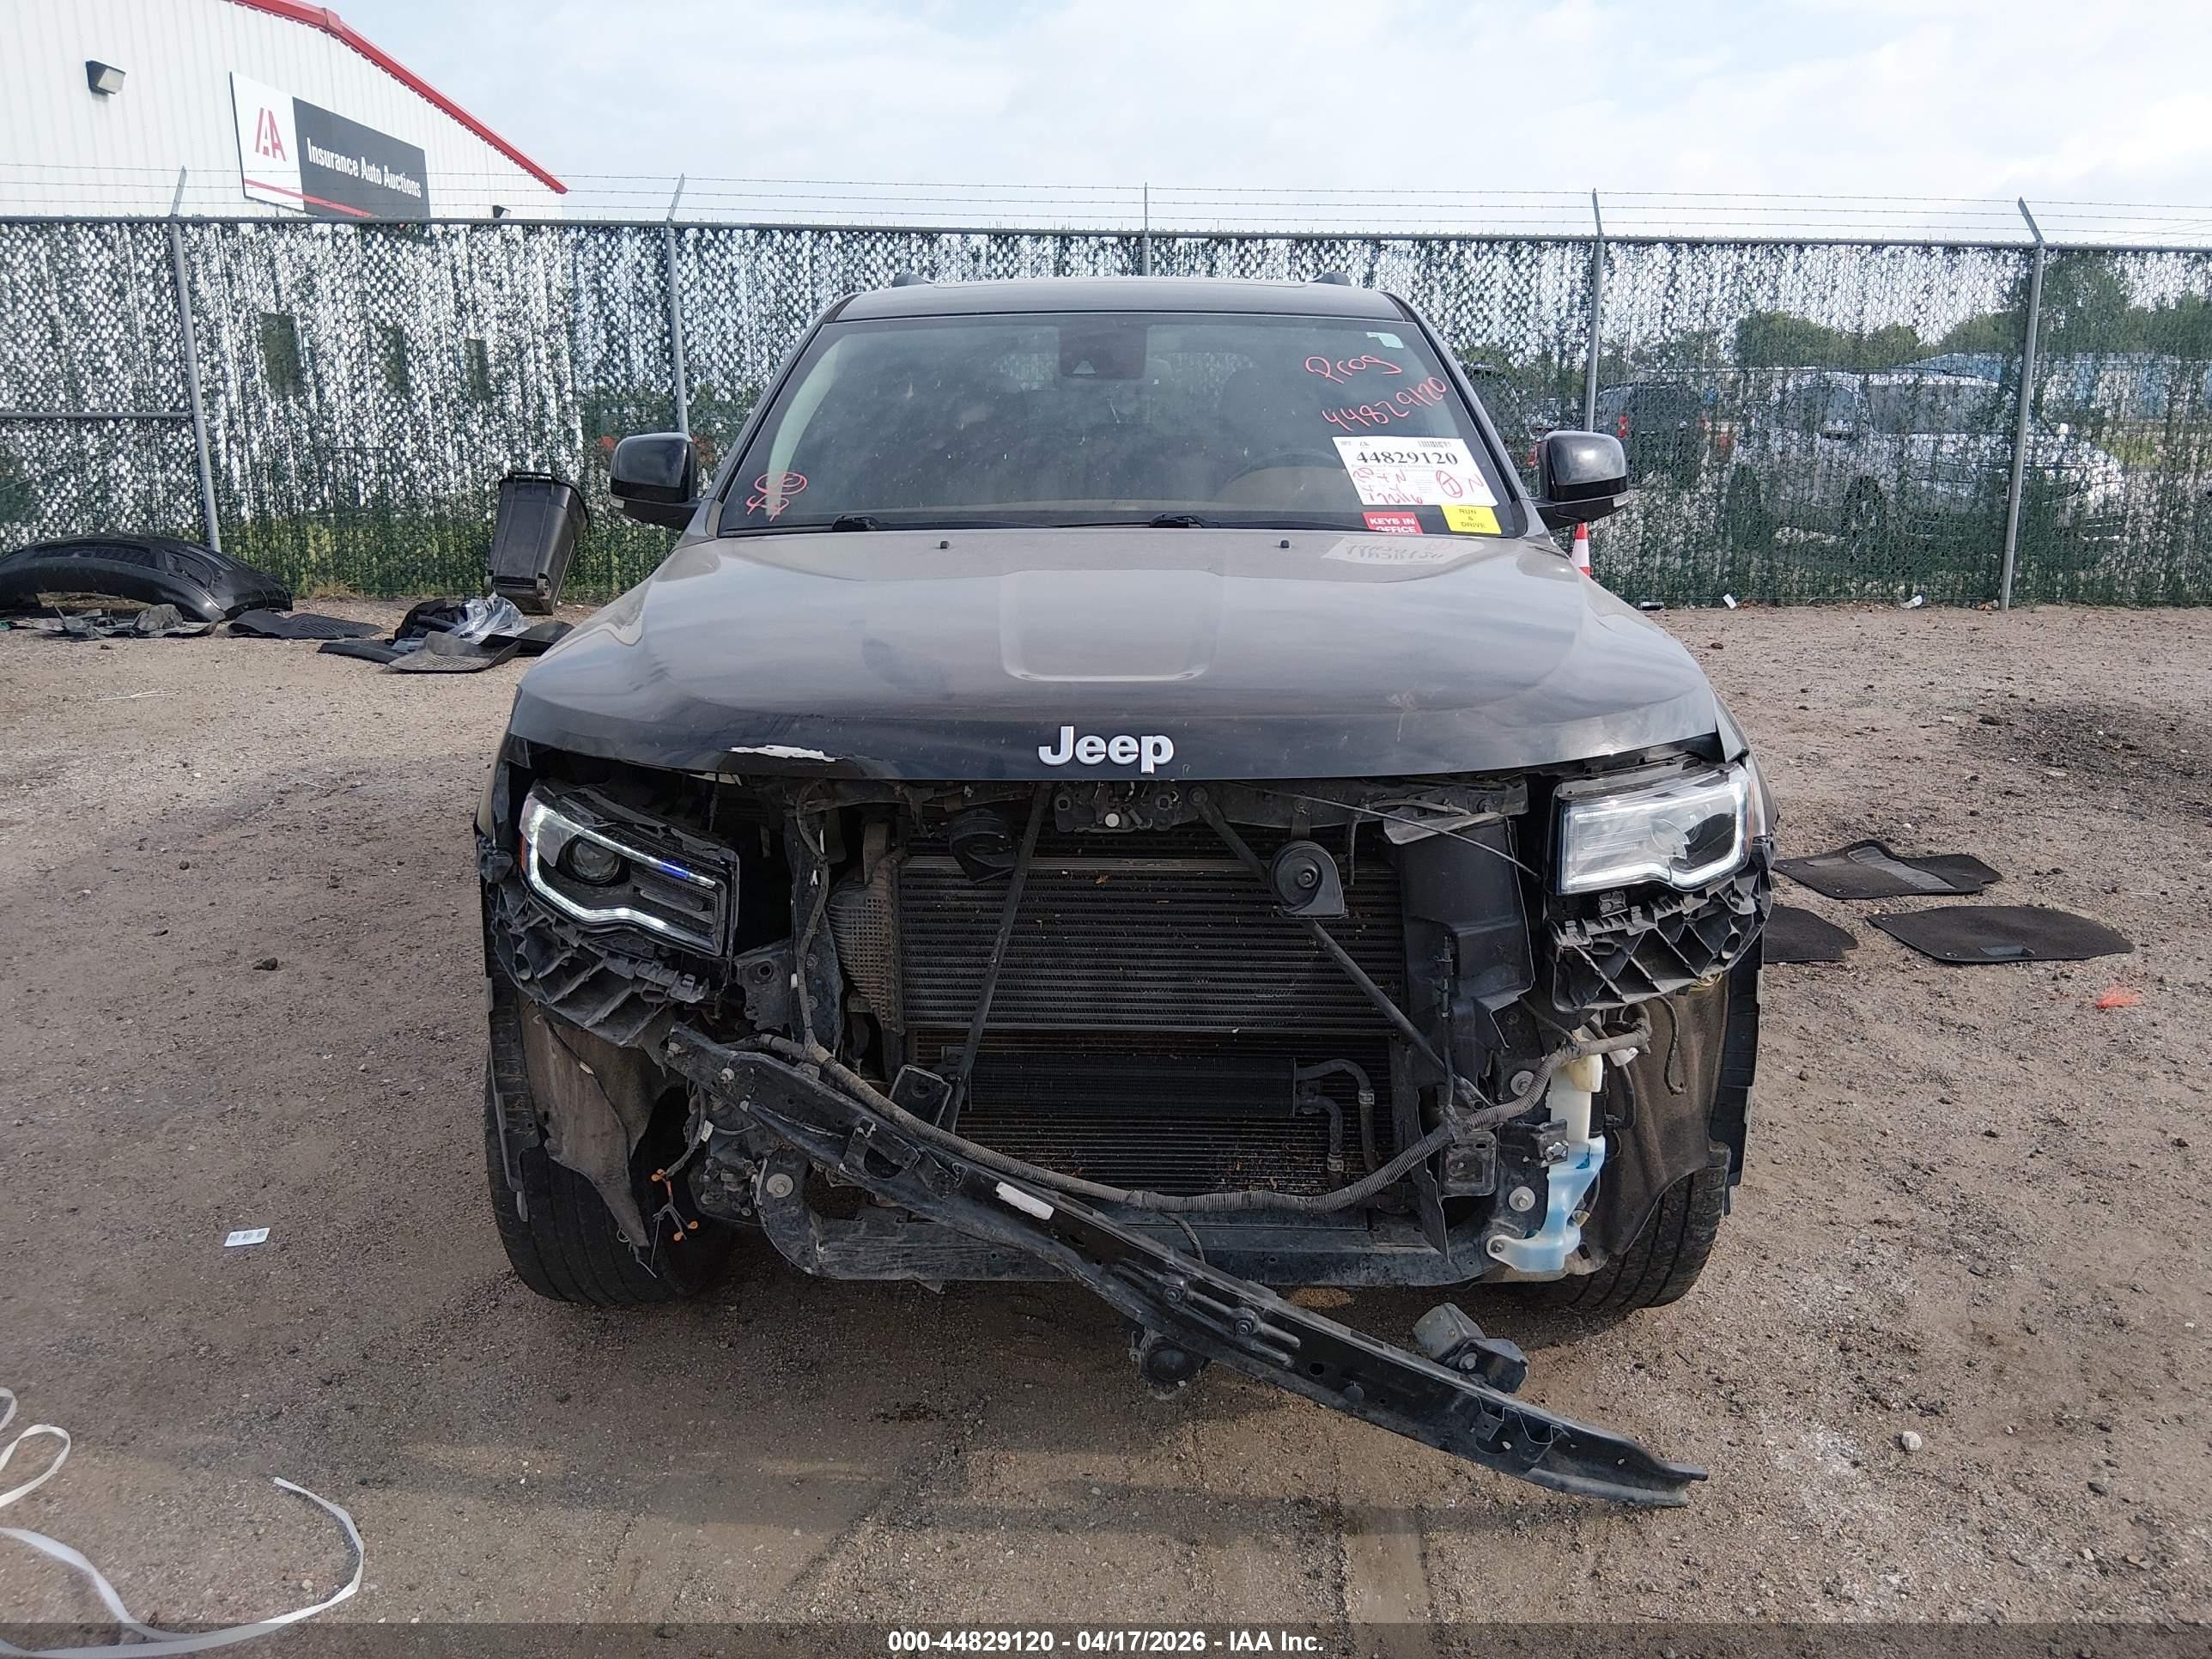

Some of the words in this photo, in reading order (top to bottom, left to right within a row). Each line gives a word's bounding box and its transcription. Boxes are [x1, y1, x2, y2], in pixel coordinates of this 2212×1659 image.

[307, 137, 359, 178] Insurance
[361, 156, 382, 185] Auto
[384, 165, 422, 198] Auctions
[1356, 451, 1458, 465] 44829120
[1038, 726, 1175, 774] Jeep
